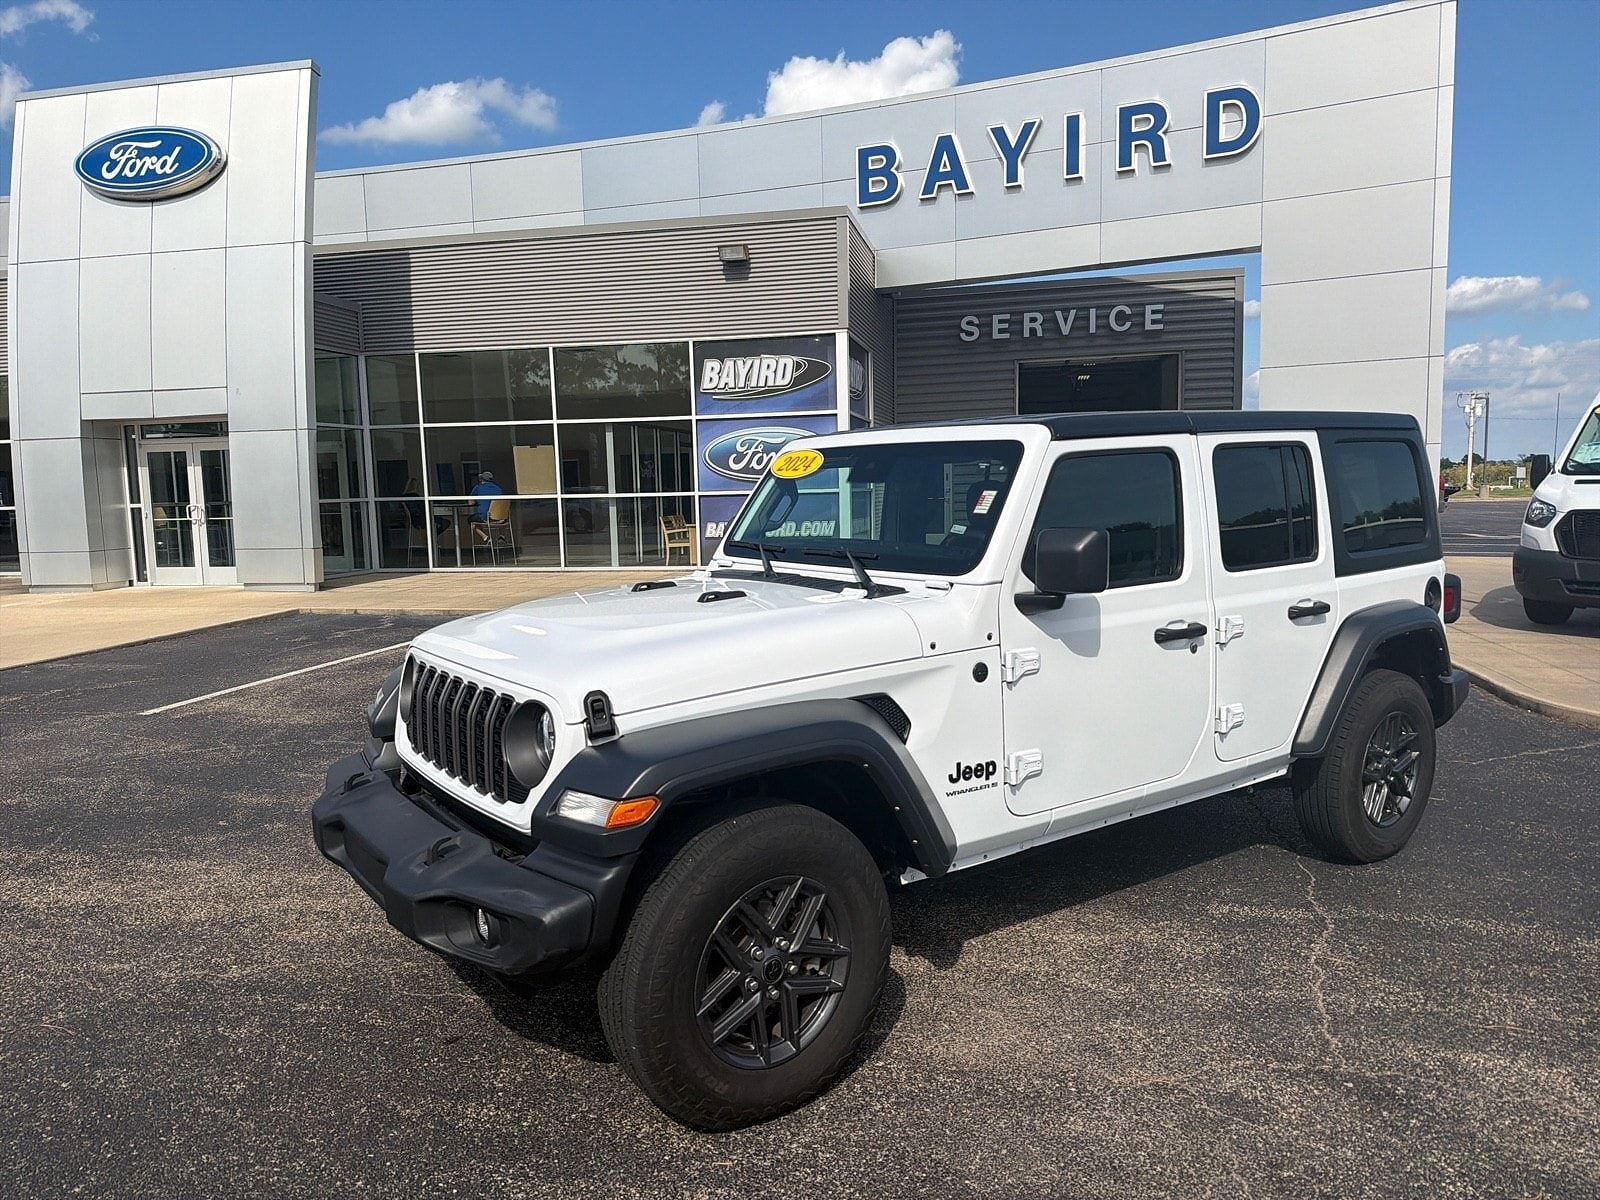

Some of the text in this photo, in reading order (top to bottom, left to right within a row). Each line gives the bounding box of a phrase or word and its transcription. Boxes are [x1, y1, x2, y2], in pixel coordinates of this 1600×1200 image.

[101, 140, 182, 180] Ford
[856, 83, 1264, 208] BAYIRD
[959, 303, 1165, 342] SERVICE
[701, 356, 795, 391] BAYIRD
[729, 436, 786, 470] Fo
[777, 455, 817, 471] 2024
[948, 760, 997, 784] Jeep
[945, 783, 990, 797] WRANGLER
